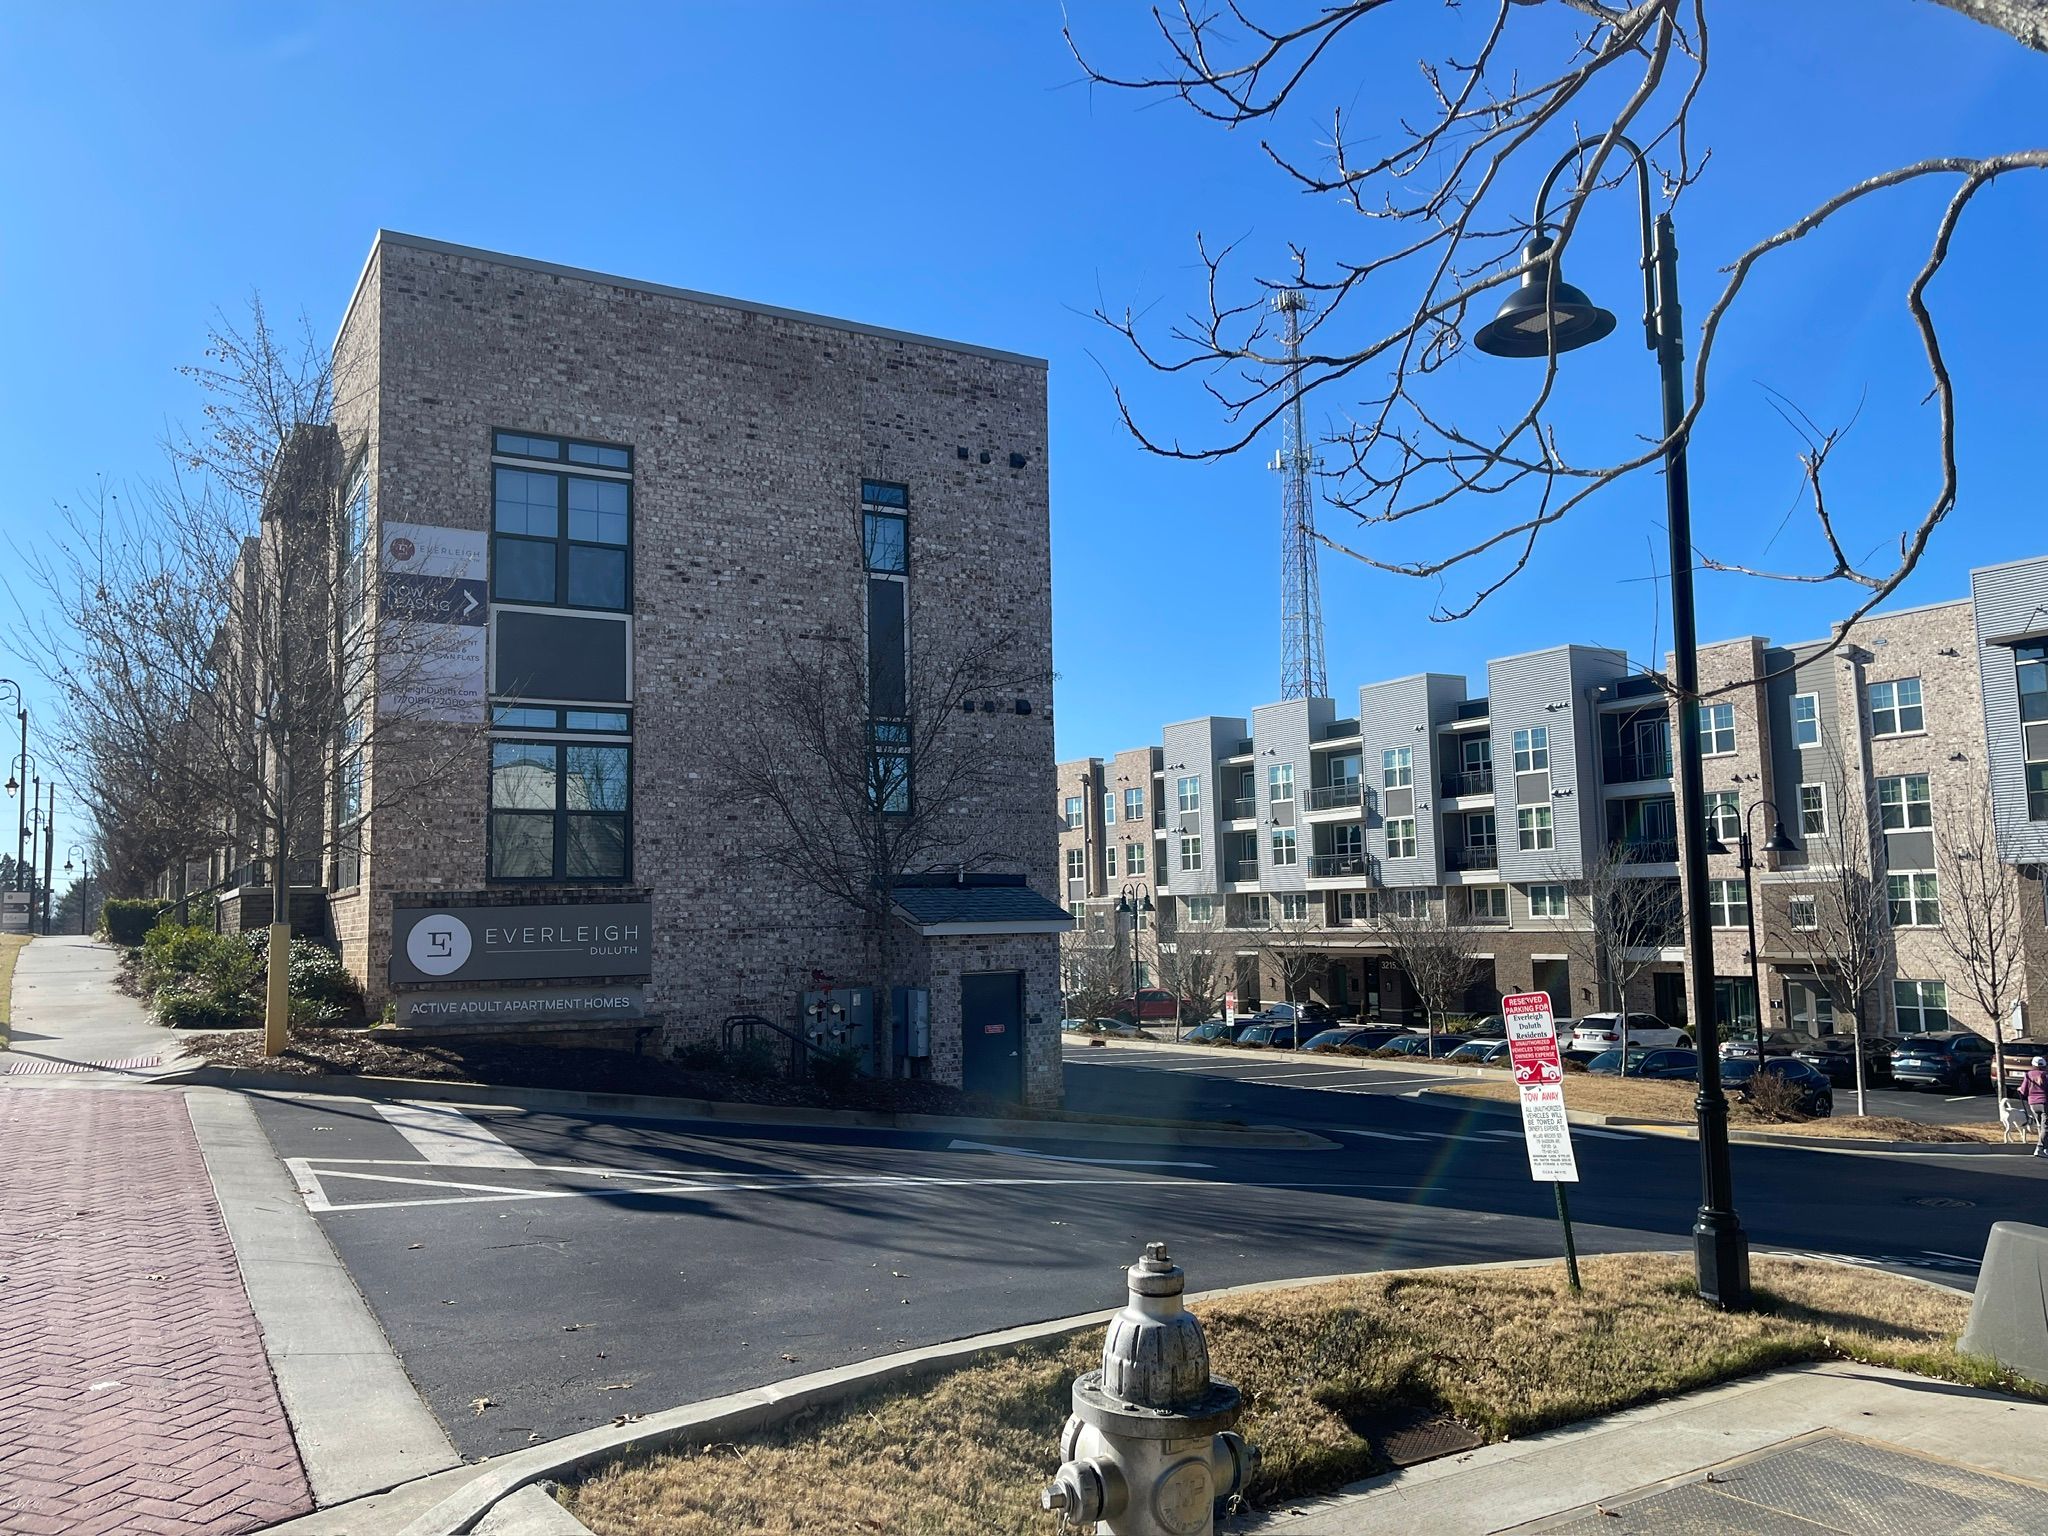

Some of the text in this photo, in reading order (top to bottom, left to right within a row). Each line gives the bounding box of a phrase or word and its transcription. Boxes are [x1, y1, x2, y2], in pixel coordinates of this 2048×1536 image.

[457, 654, 480, 662] FLATS
[485, 925, 639, 944] EVERLEIGH
[590, 946, 638, 956] DULUTH
[1381, 961, 1397, 970] 3215
[1508, 996, 1543, 1006] RESERVED
[410, 997, 630, 1015] ACTIVE ADULT APARTMENT HOMES
[1505, 1003, 1549, 1014] PARKING FOR
[1513, 1013, 1543, 1022] Everleigh
[1519, 1022, 1541, 1030] Duluth
[1516, 1031, 1548, 1040] Residents
[1515, 1039, 1551, 1047] UNAUTHORIZED
[1524, 1091, 1559, 1102] TOW AWAY
